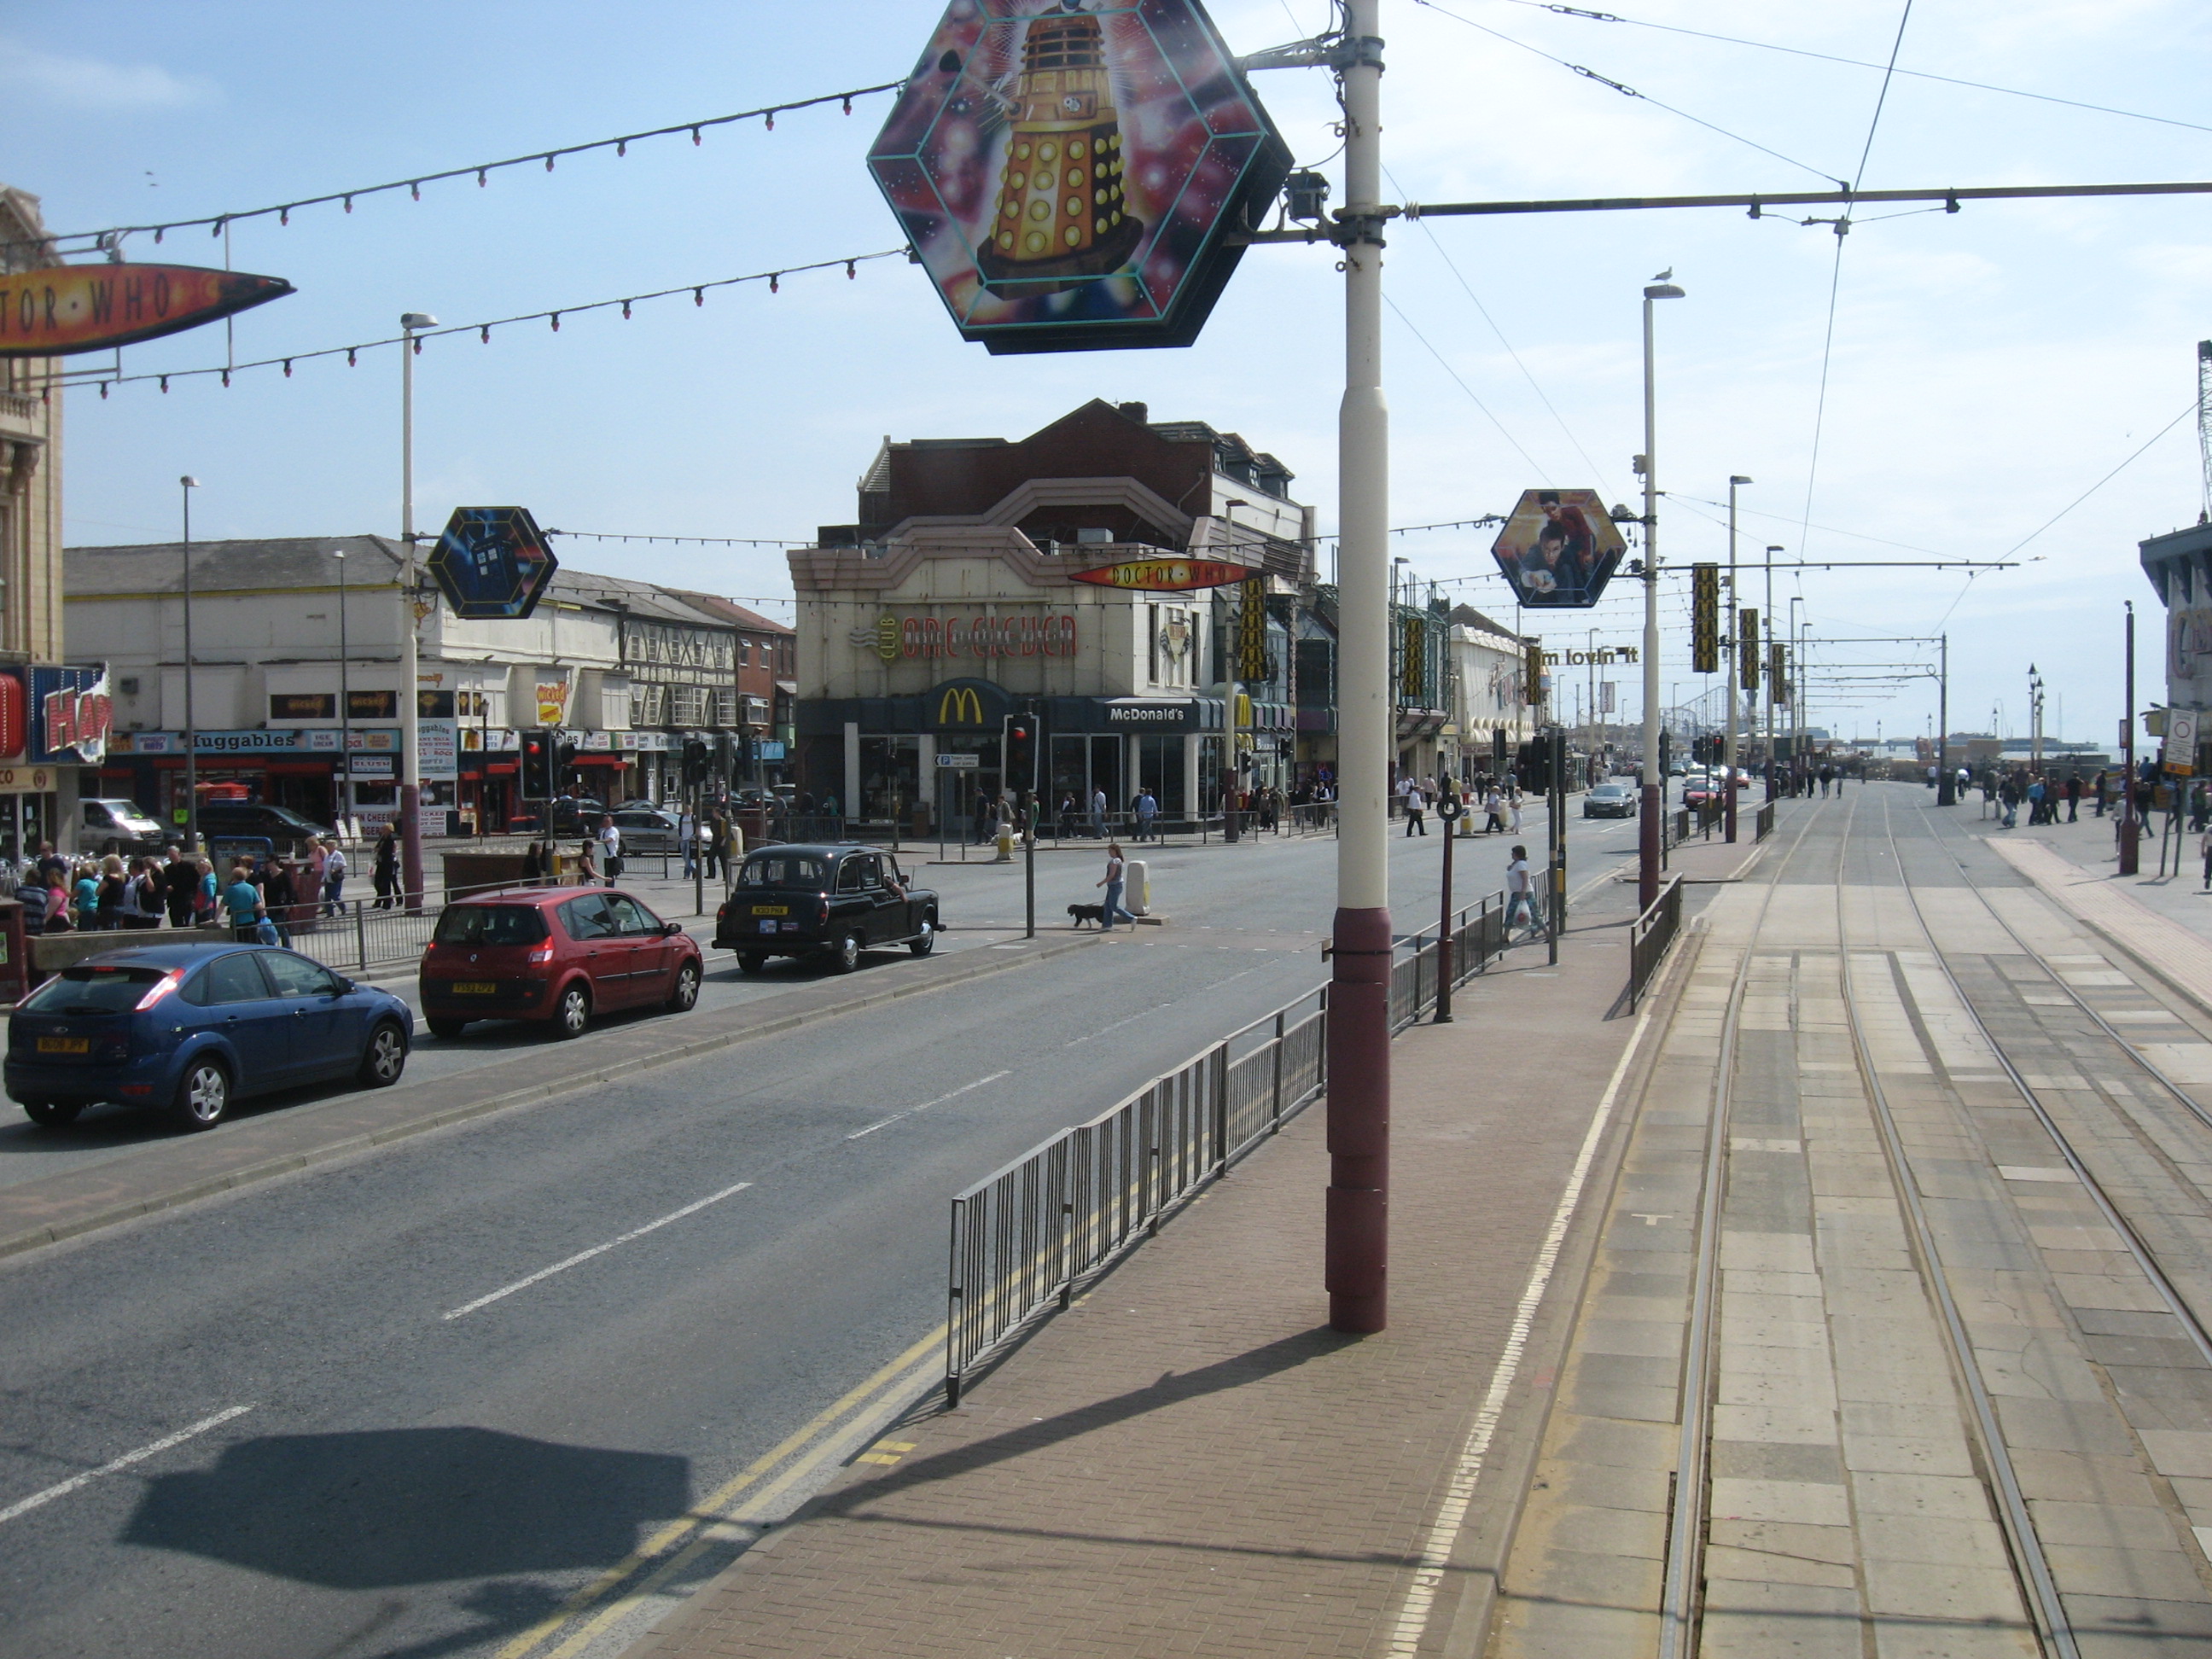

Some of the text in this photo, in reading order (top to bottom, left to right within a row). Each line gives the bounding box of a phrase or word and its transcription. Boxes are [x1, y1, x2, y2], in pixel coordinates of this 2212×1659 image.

[89, 272, 169, 324] WHO
[1111, 565, 1226, 585] DOCTOR WHO
[880, 617, 896, 659] CLUB
[1110, 708, 1185, 721] McDonald's
